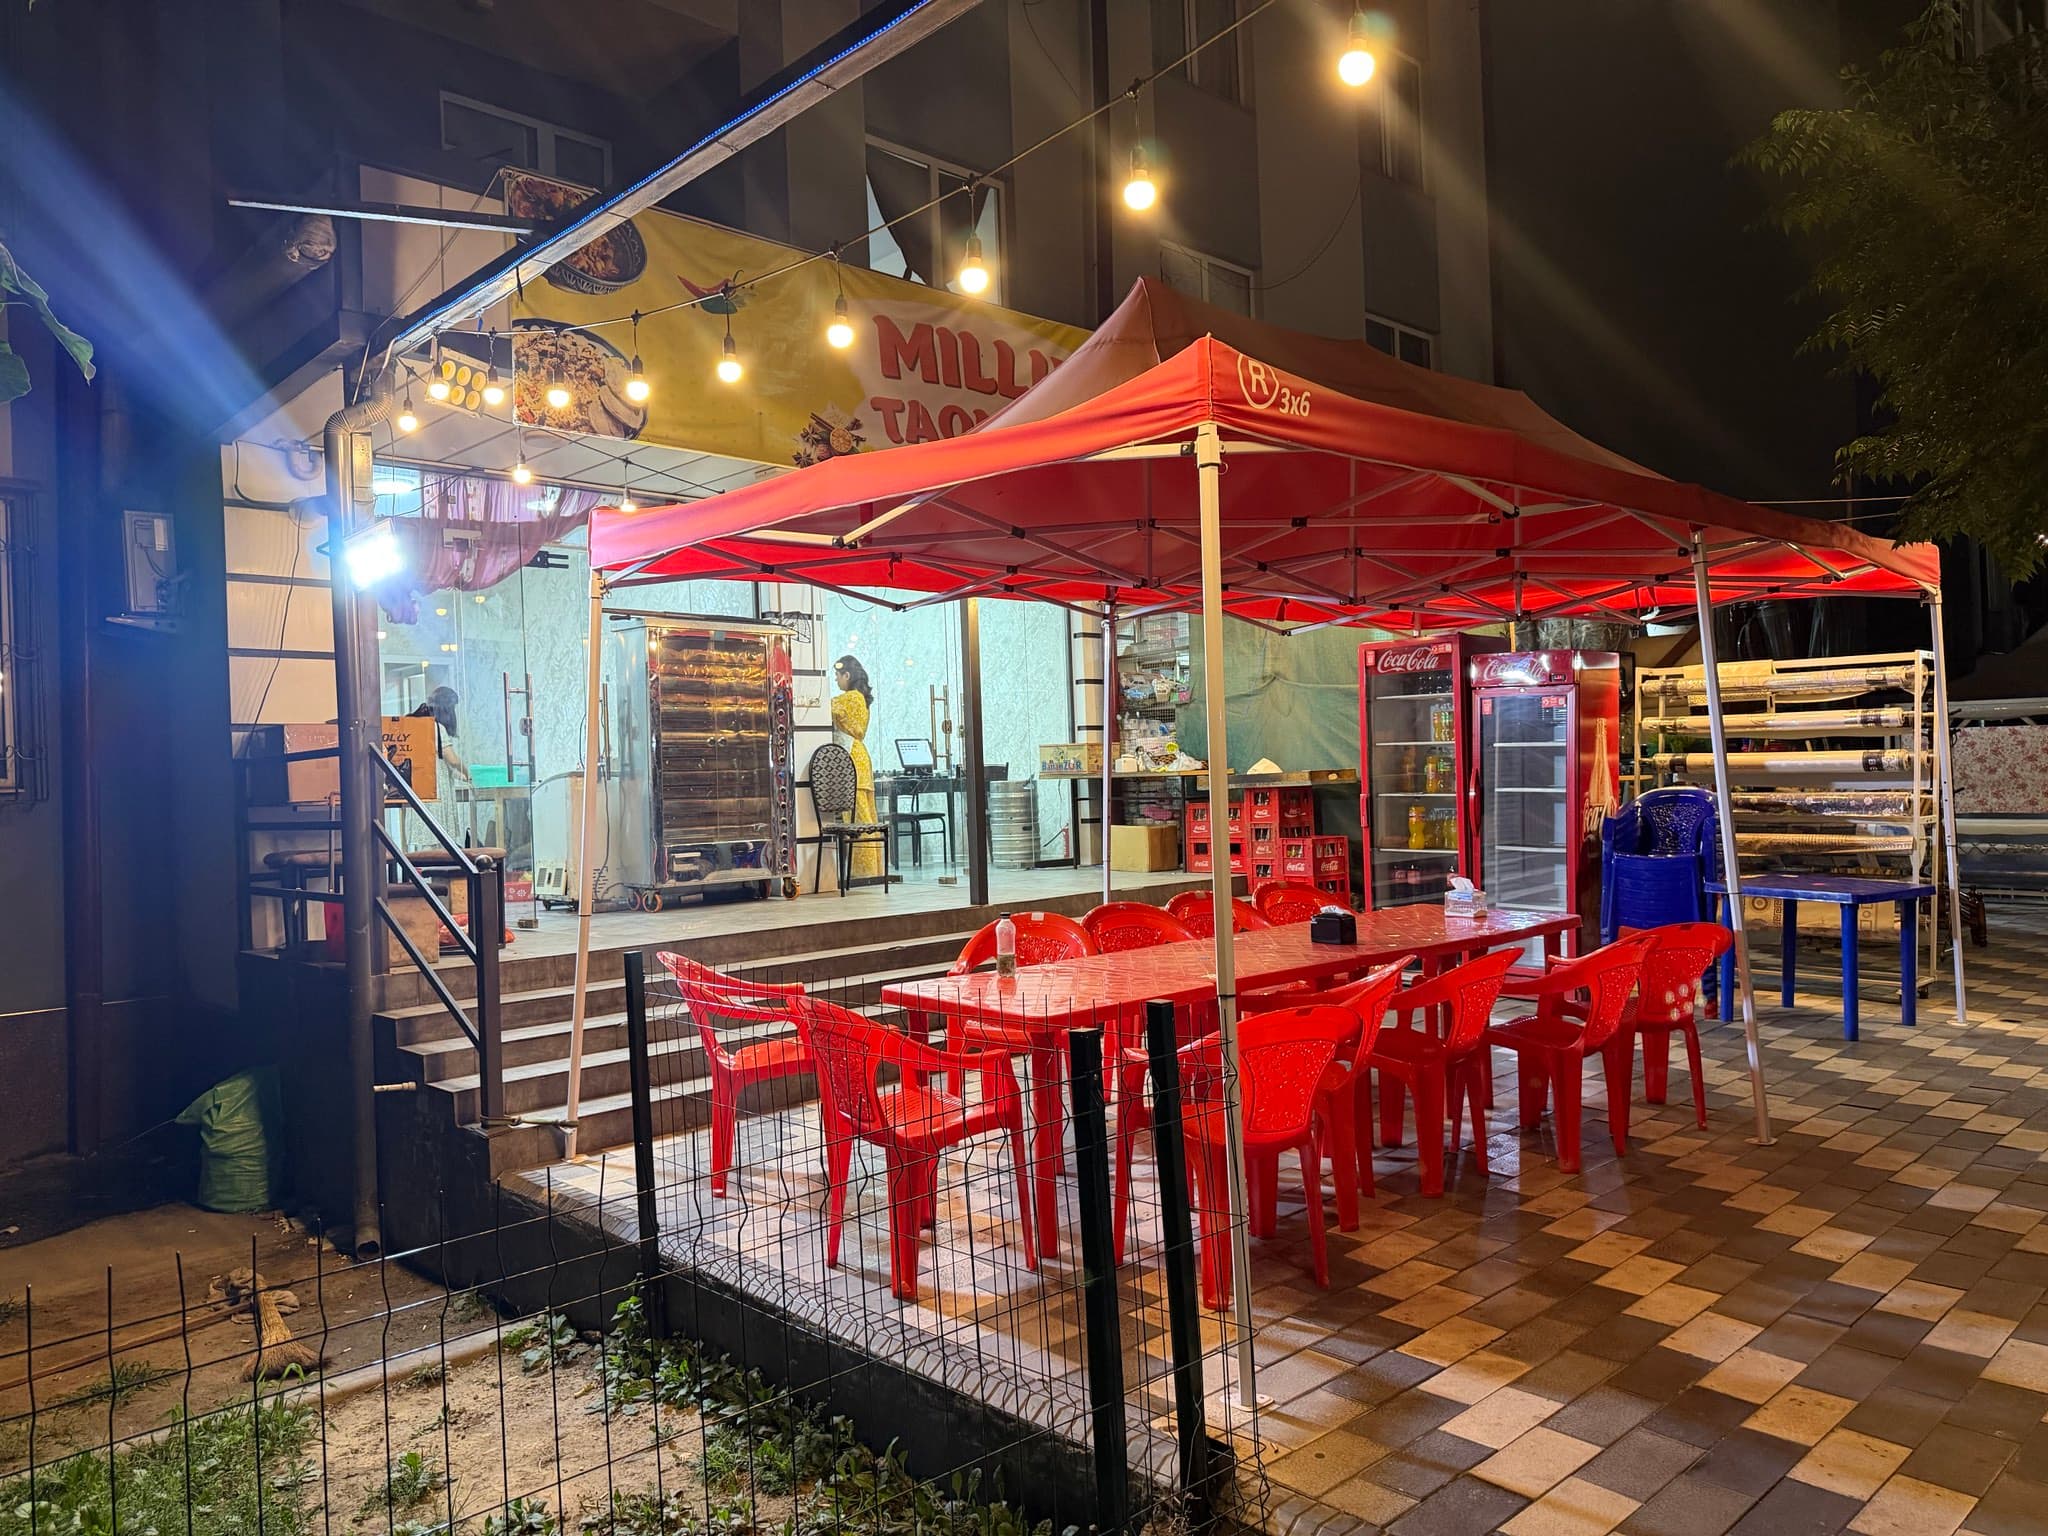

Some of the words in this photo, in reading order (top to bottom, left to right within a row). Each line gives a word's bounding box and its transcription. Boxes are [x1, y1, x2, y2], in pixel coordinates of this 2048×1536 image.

[872, 314, 1063, 400] MILLI
[1280, 387, 1311, 416] 3x6
[870, 396, 990, 444] TAO
[1377, 646, 1439, 673] Coca-Cola
[382, 733, 410, 742] OLLY
